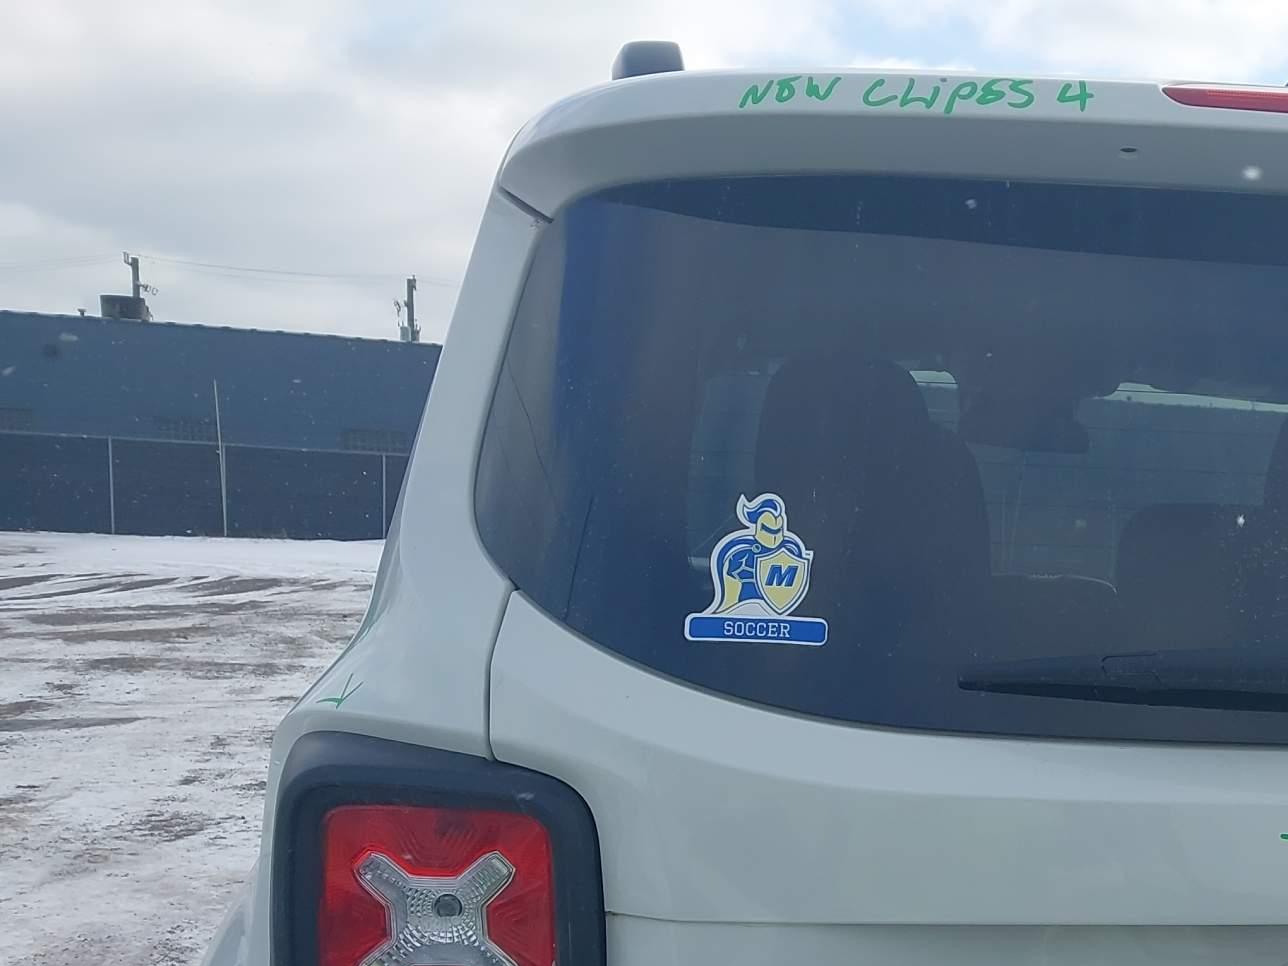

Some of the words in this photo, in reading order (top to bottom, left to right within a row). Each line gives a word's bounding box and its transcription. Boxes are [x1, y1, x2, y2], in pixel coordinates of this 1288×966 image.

[1056, 80, 1094, 112] 4
[765, 565, 798, 587] M
[723, 621, 791, 638] SOCCER
